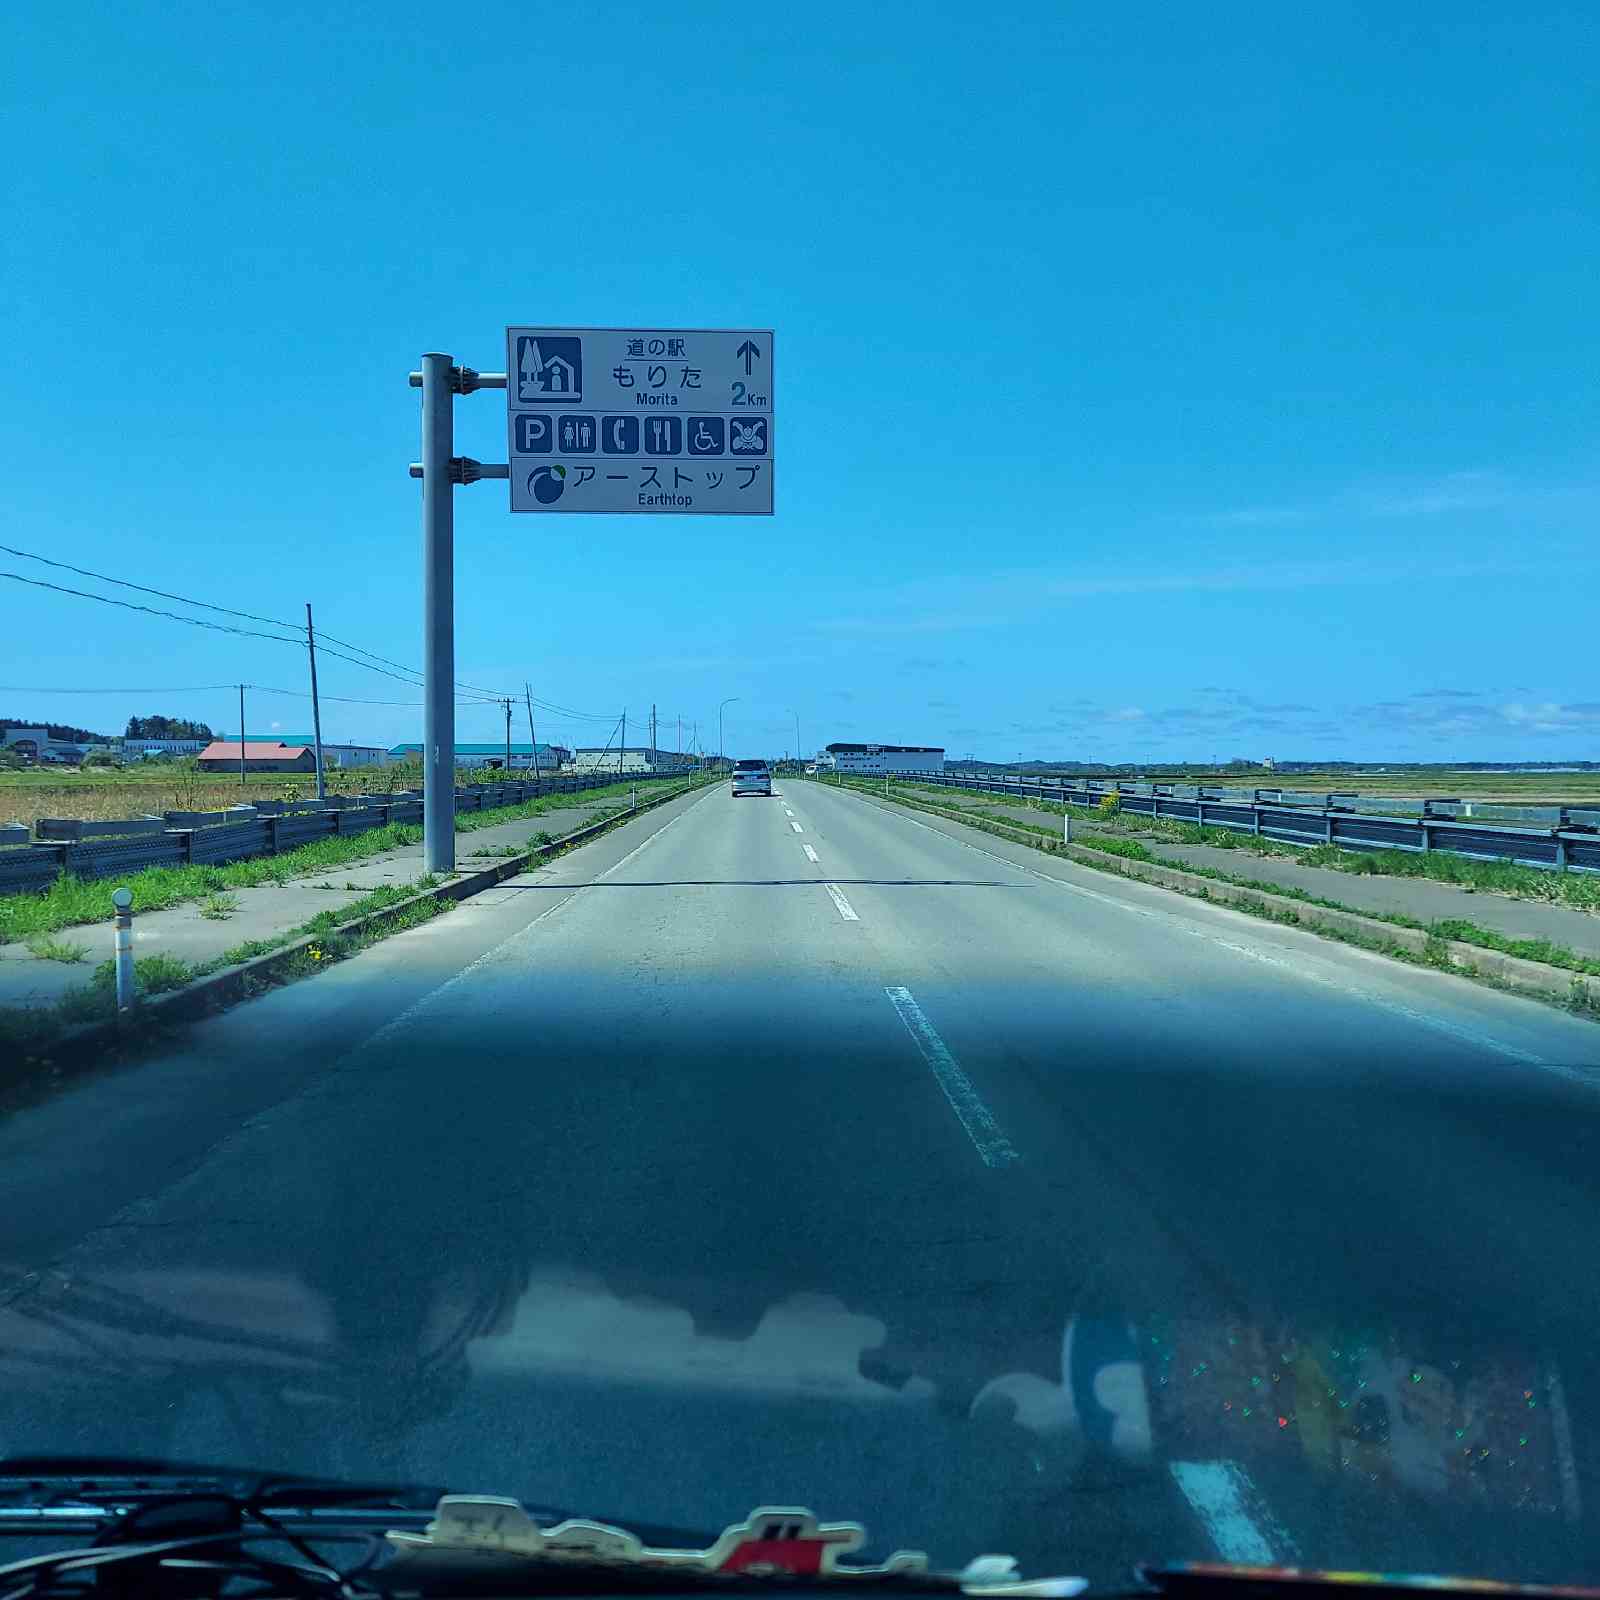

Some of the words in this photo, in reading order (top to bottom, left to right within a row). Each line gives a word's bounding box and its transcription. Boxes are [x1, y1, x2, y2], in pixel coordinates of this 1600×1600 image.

[627, 338, 686, 357] 道の駅
[612, 365, 702, 389] もりた
[636, 392, 679, 406] Morita
[573, 464, 761, 490] アーストップ
[638, 493, 693, 508] Earthtop
